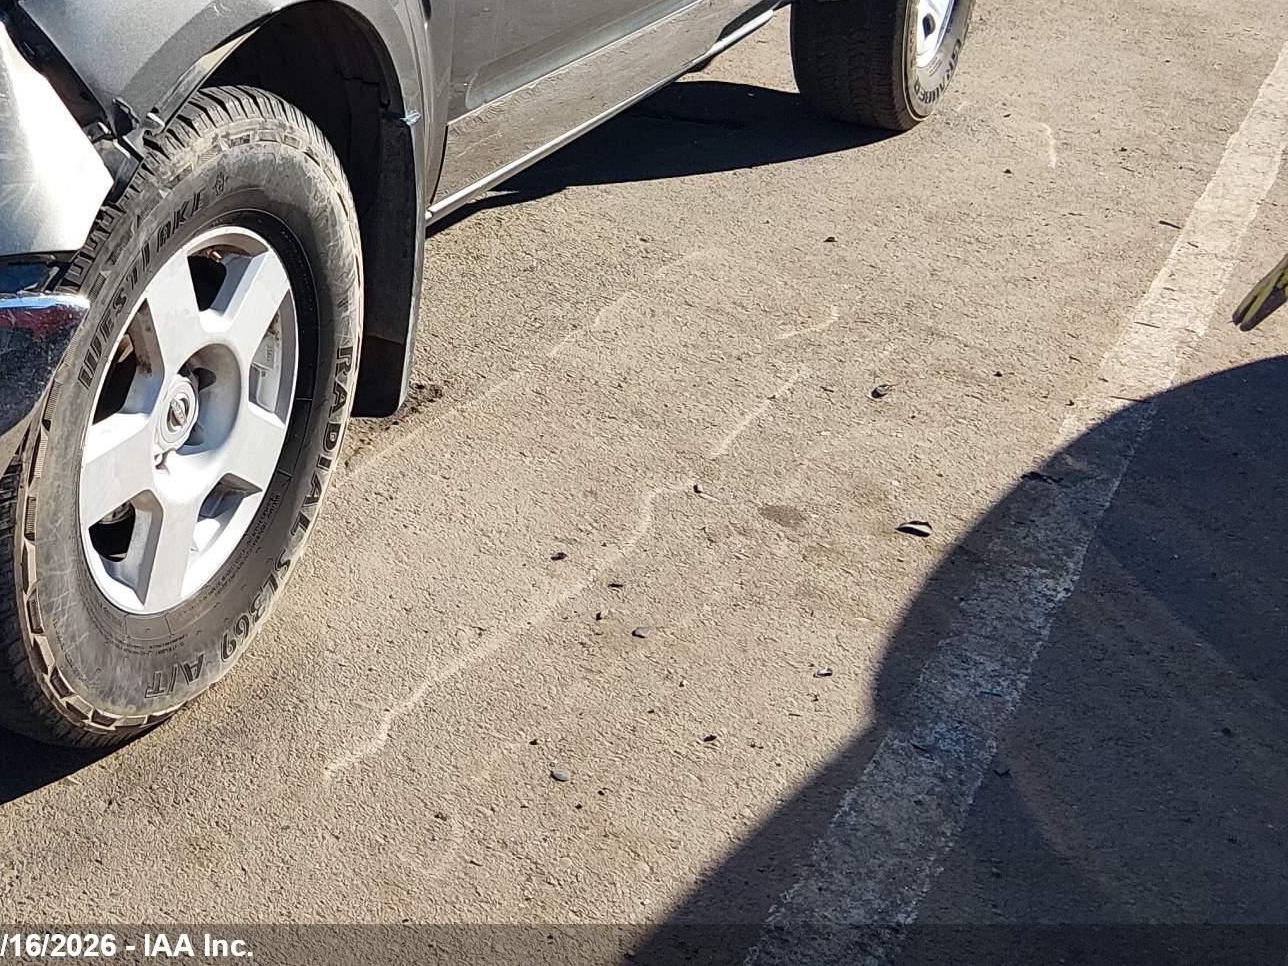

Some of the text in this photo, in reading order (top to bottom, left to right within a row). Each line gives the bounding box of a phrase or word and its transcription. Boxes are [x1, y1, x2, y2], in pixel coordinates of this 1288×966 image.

[143, 346, 354, 699] RADIAL SL369 A/T
